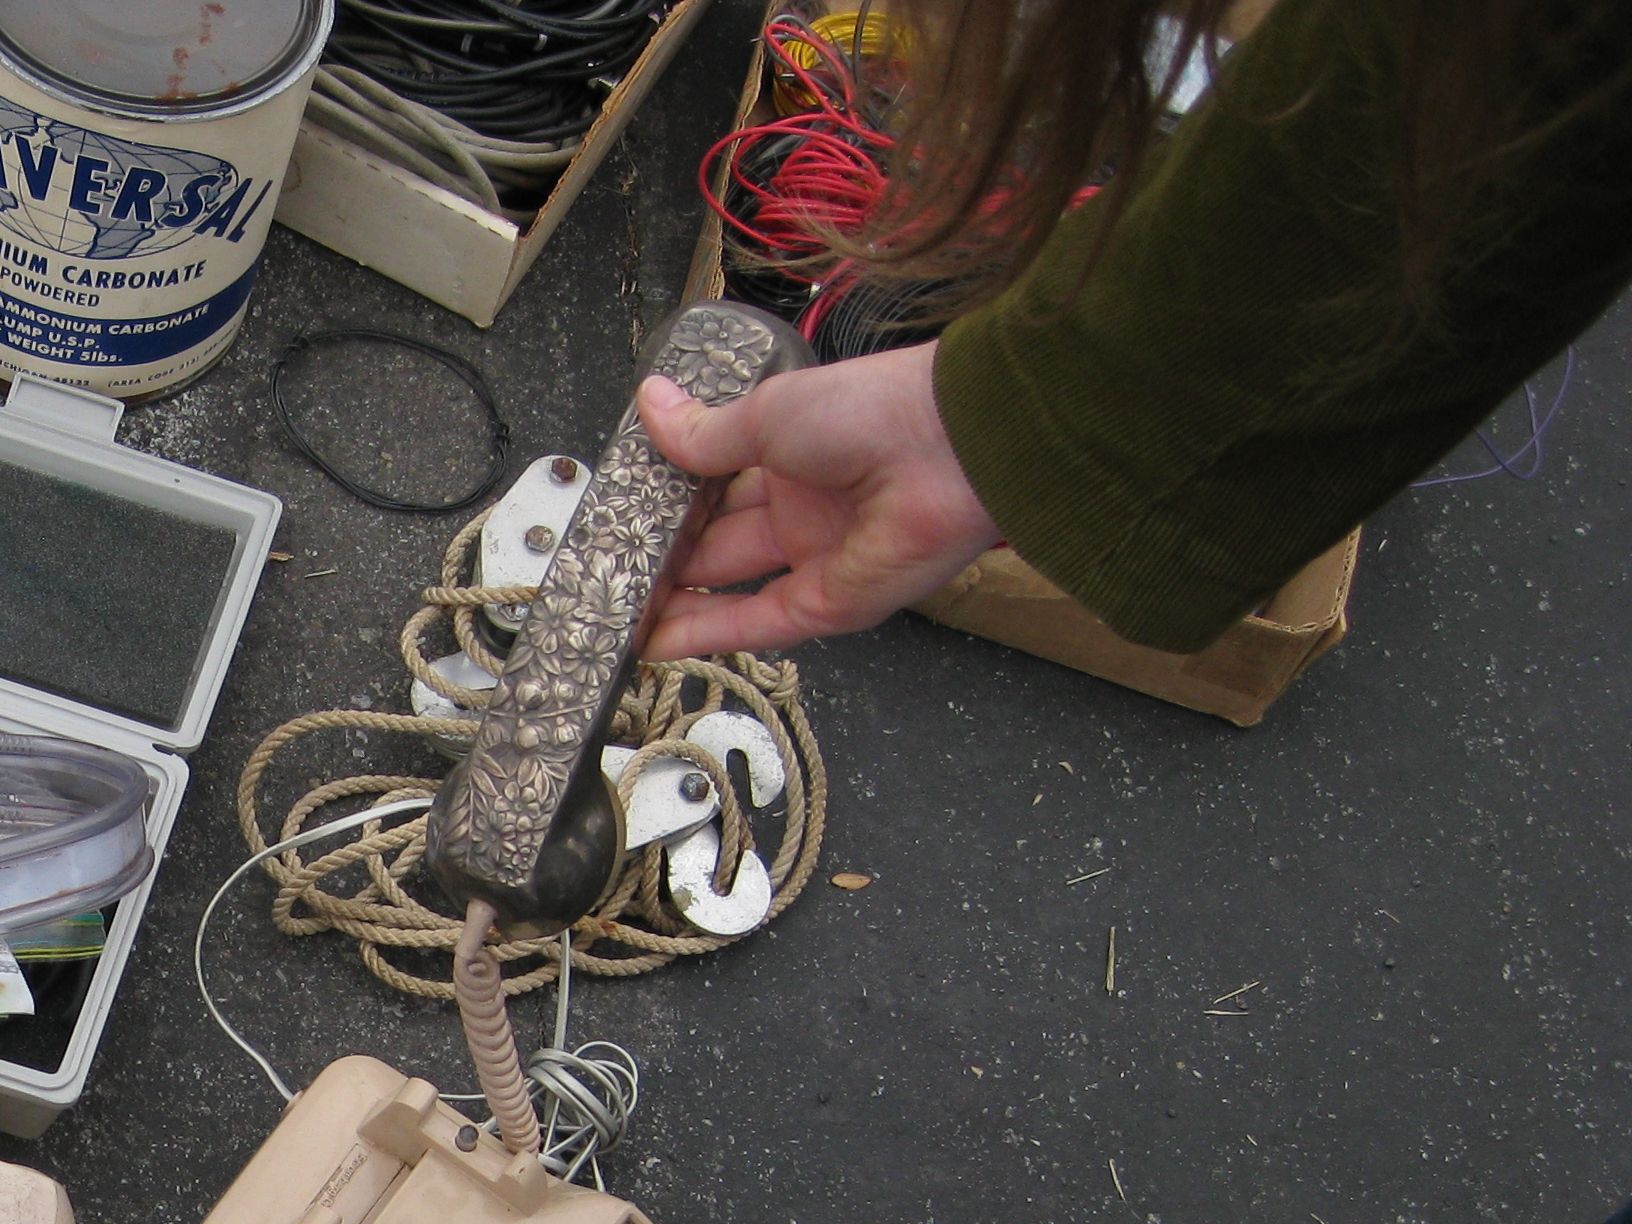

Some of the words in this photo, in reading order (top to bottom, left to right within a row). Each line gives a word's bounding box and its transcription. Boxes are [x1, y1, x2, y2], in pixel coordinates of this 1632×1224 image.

[0, 265, 101, 308] POWDERED
[61, 259, 208, 290] CARBONATE
[108, 303, 210, 335] CARBONATE
[7, 332, 74, 360] WEIGHT
[80, 350, 123, 363] 5lbs.
[48, 331, 101, 349] U.S.P.
